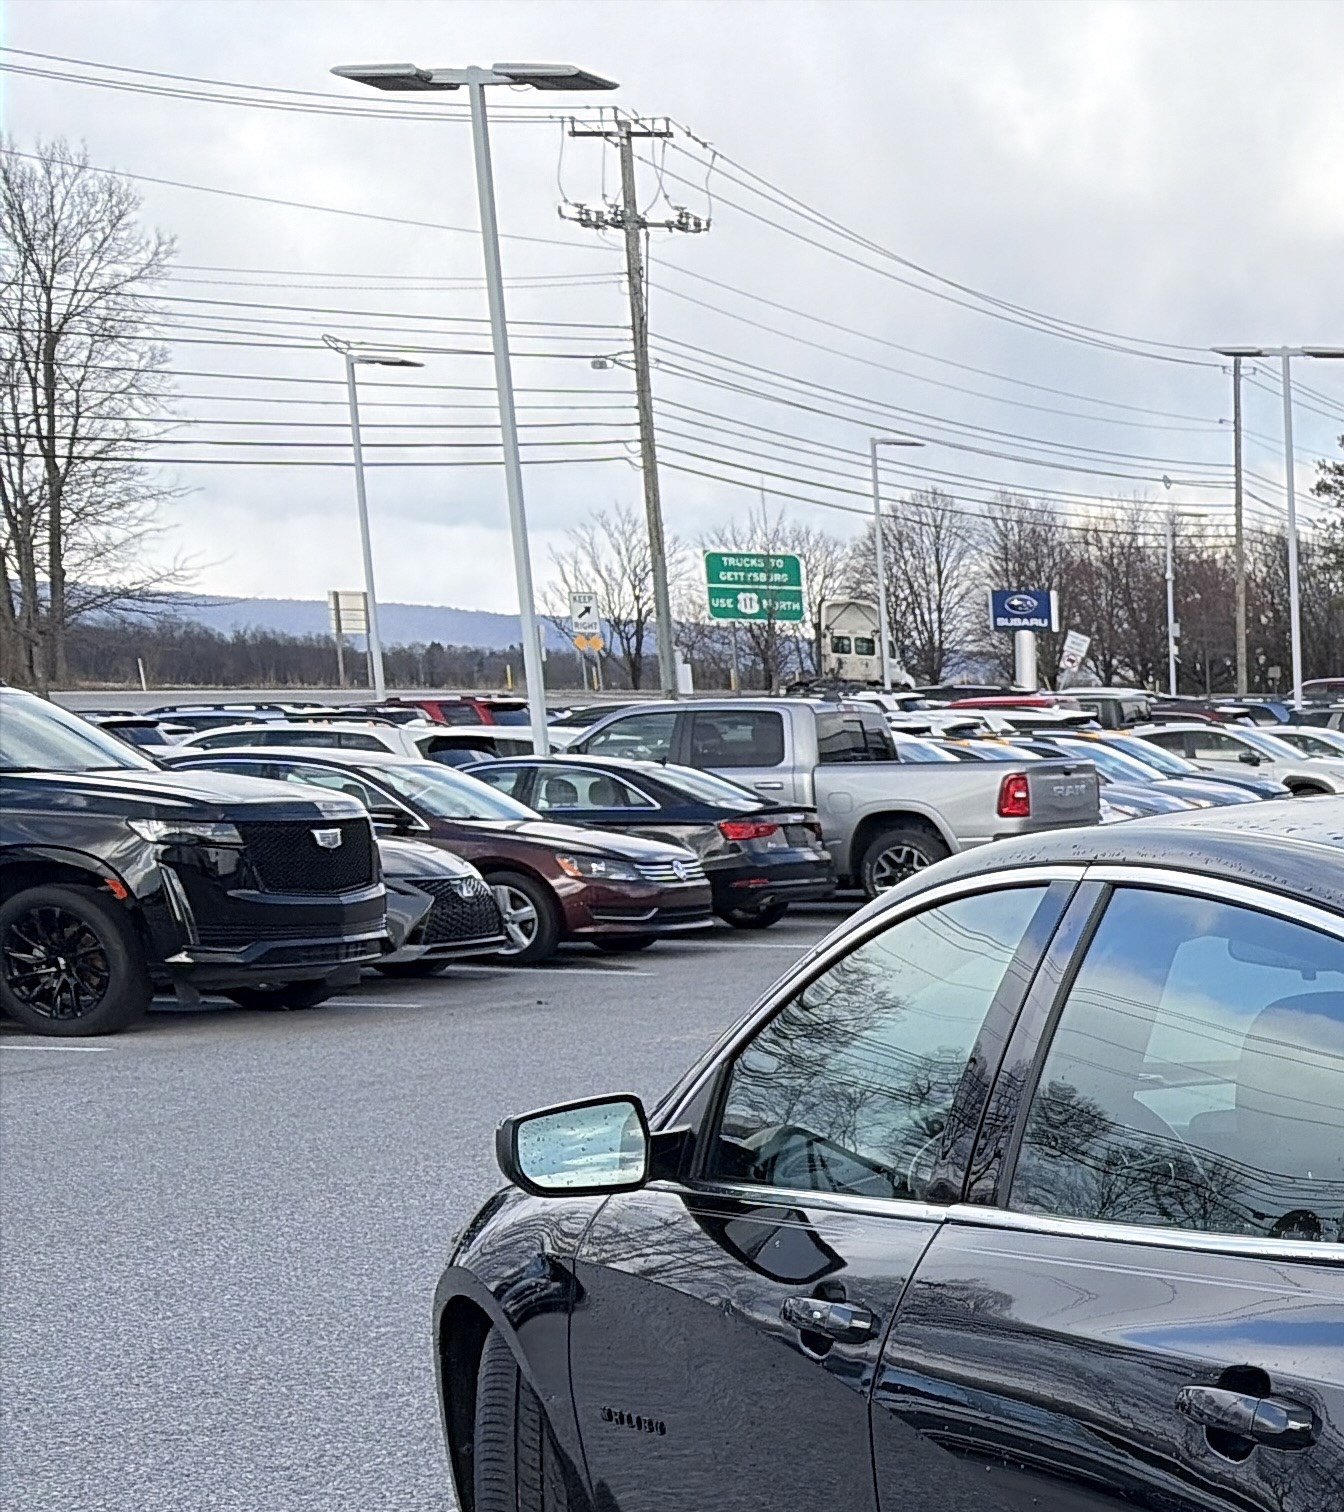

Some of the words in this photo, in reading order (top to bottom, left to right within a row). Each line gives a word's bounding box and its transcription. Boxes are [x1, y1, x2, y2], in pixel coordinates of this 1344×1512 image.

[721, 556, 765, 568] TRUCKS
[769, 558, 785, 569] TO
[719, 571, 789, 583] GETTYSBURG
[572, 595, 593, 604] KEEP
[711, 598, 734, 608] USE
[743, 597, 754, 610] 11
[573, 621, 598, 630] RIGHT
[996, 617, 1048, 627] SUBARU
